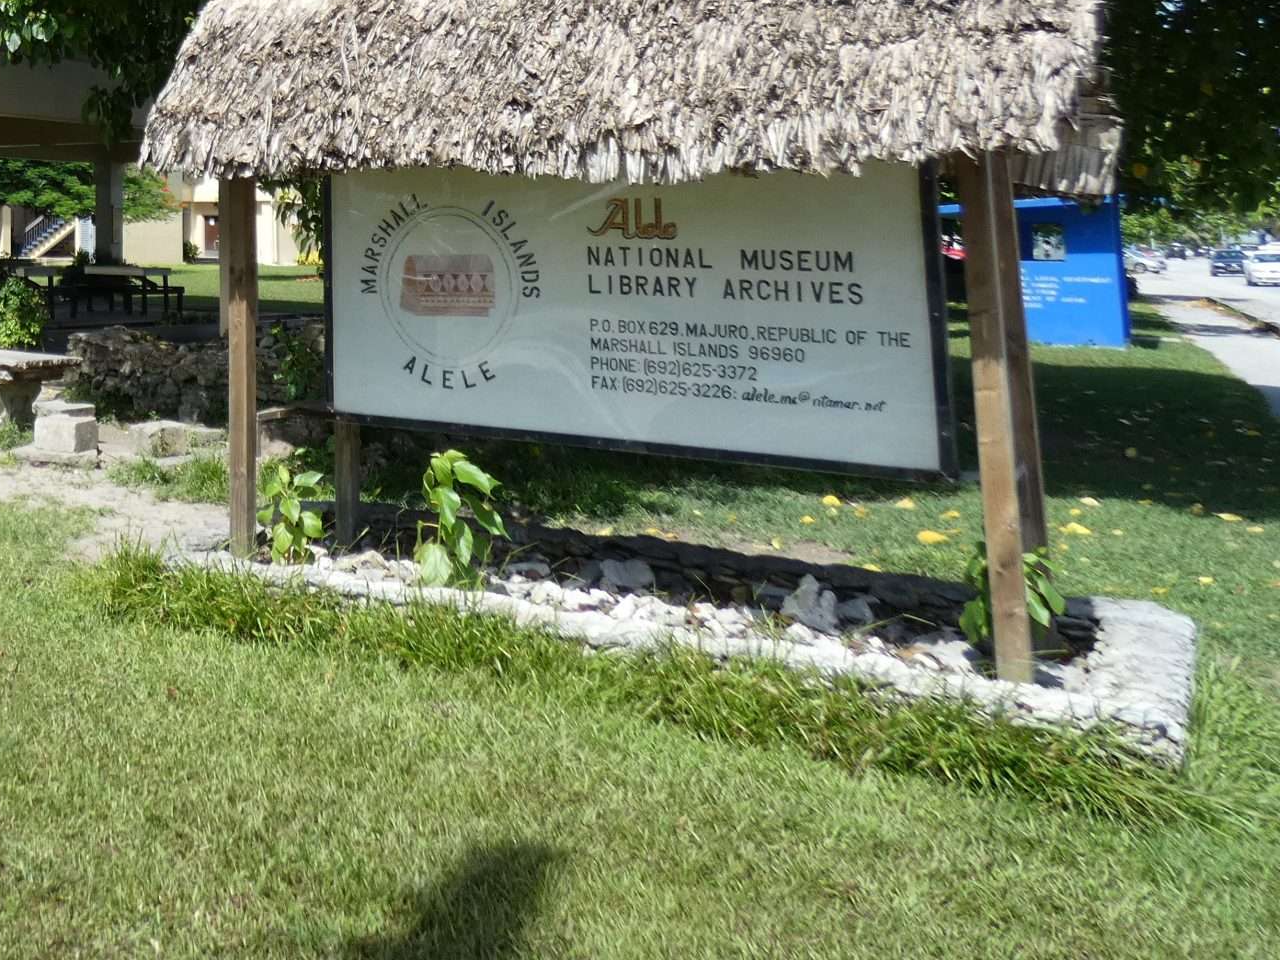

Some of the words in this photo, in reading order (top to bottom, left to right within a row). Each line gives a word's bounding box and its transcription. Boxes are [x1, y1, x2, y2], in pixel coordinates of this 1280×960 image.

[586, 198, 678, 240] Alele
[360, 193, 428, 295] MARSHALL
[482, 199, 540, 299] ISLANDS
[586, 246, 713, 269] NATIONAL
[740, 249, 854, 273] MUSEUM
[587, 274, 697, 298] LIBRARY
[723, 278, 864, 305] ARCHIVES
[617, 320, 646, 335] BOX
[756, 326, 837, 344] REPUBLIC
[845, 329, 868, 345] OF
[876, 331, 911, 348] THE
[590, 338, 667, 355] MARSHALL
[673, 342, 740, 359] ISLANDS
[748, 345, 805, 363] 96960
[402, 356, 496, 389] ALELE
